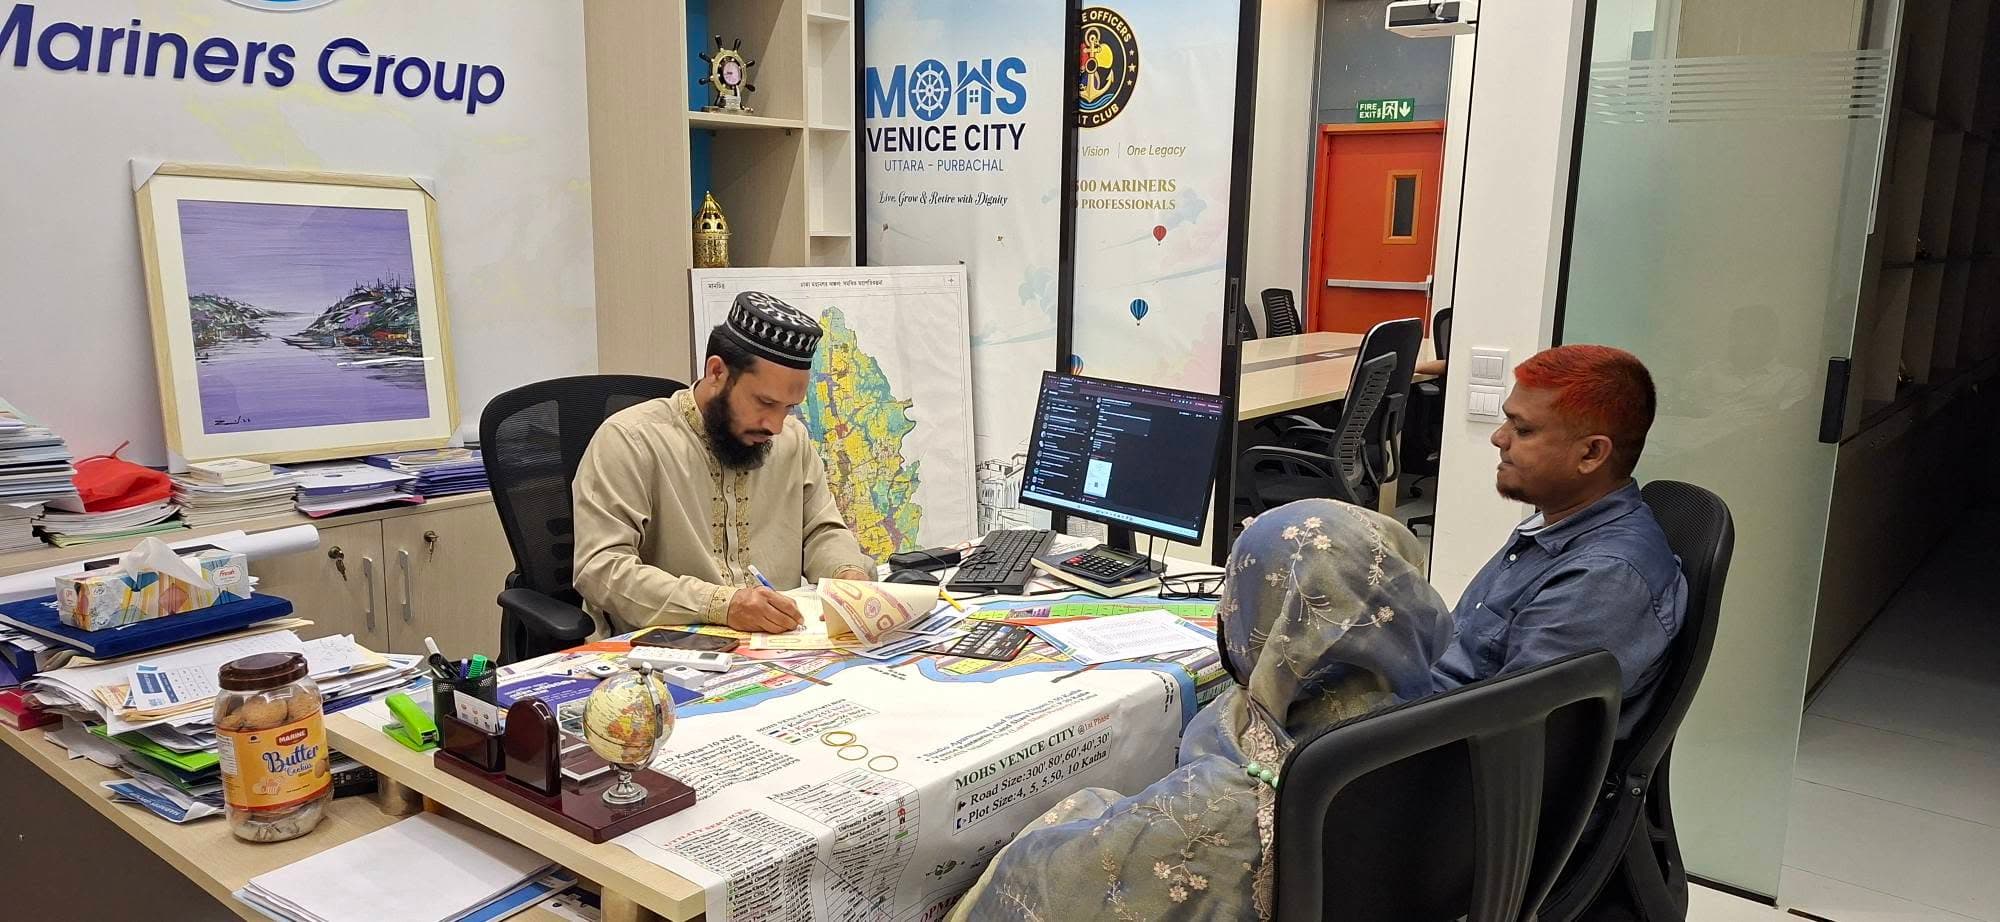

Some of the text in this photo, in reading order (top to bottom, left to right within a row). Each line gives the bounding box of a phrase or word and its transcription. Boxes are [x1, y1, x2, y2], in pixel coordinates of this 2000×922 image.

[1090, 10, 1132, 43] OFFICERS
[317, 37, 507, 115] Group
[866, 56, 1028, 122] MOHS
[1092, 103, 1120, 124] CLUB
[1360, 103, 1377, 111] FIRE
[1360, 111, 1377, 119] EXIT
[867, 123, 1026, 152] VENICE CITY
[1082, 144, 1186, 158] Vision One Legacy
[884, 159, 925, 172] UTTARA
[937, 158, 1004, 172] PURBACHAL
[1099, 179, 1177, 193] MARINERS
[898, 191, 918, 206] Grow
[919, 191, 927, 204] &
[929, 191, 955, 204] Retire
[957, 192, 973, 204] with
[975, 191, 1008, 207] Dignity
[1081, 199, 1176, 210] PROFESSIONALS
[279, 728, 306, 743] MARINE
[262, 743, 319, 773] Butter
[955, 763, 997, 791] MOHS
[1000, 741, 1046, 770] VENICE
[1048, 726, 1076, 747] CITY
[968, 806, 989, 824] Plot
[1067, 762, 1080, 775] 10
[1081, 750, 1107, 769] Katha
[970, 784, 999, 806] Road
